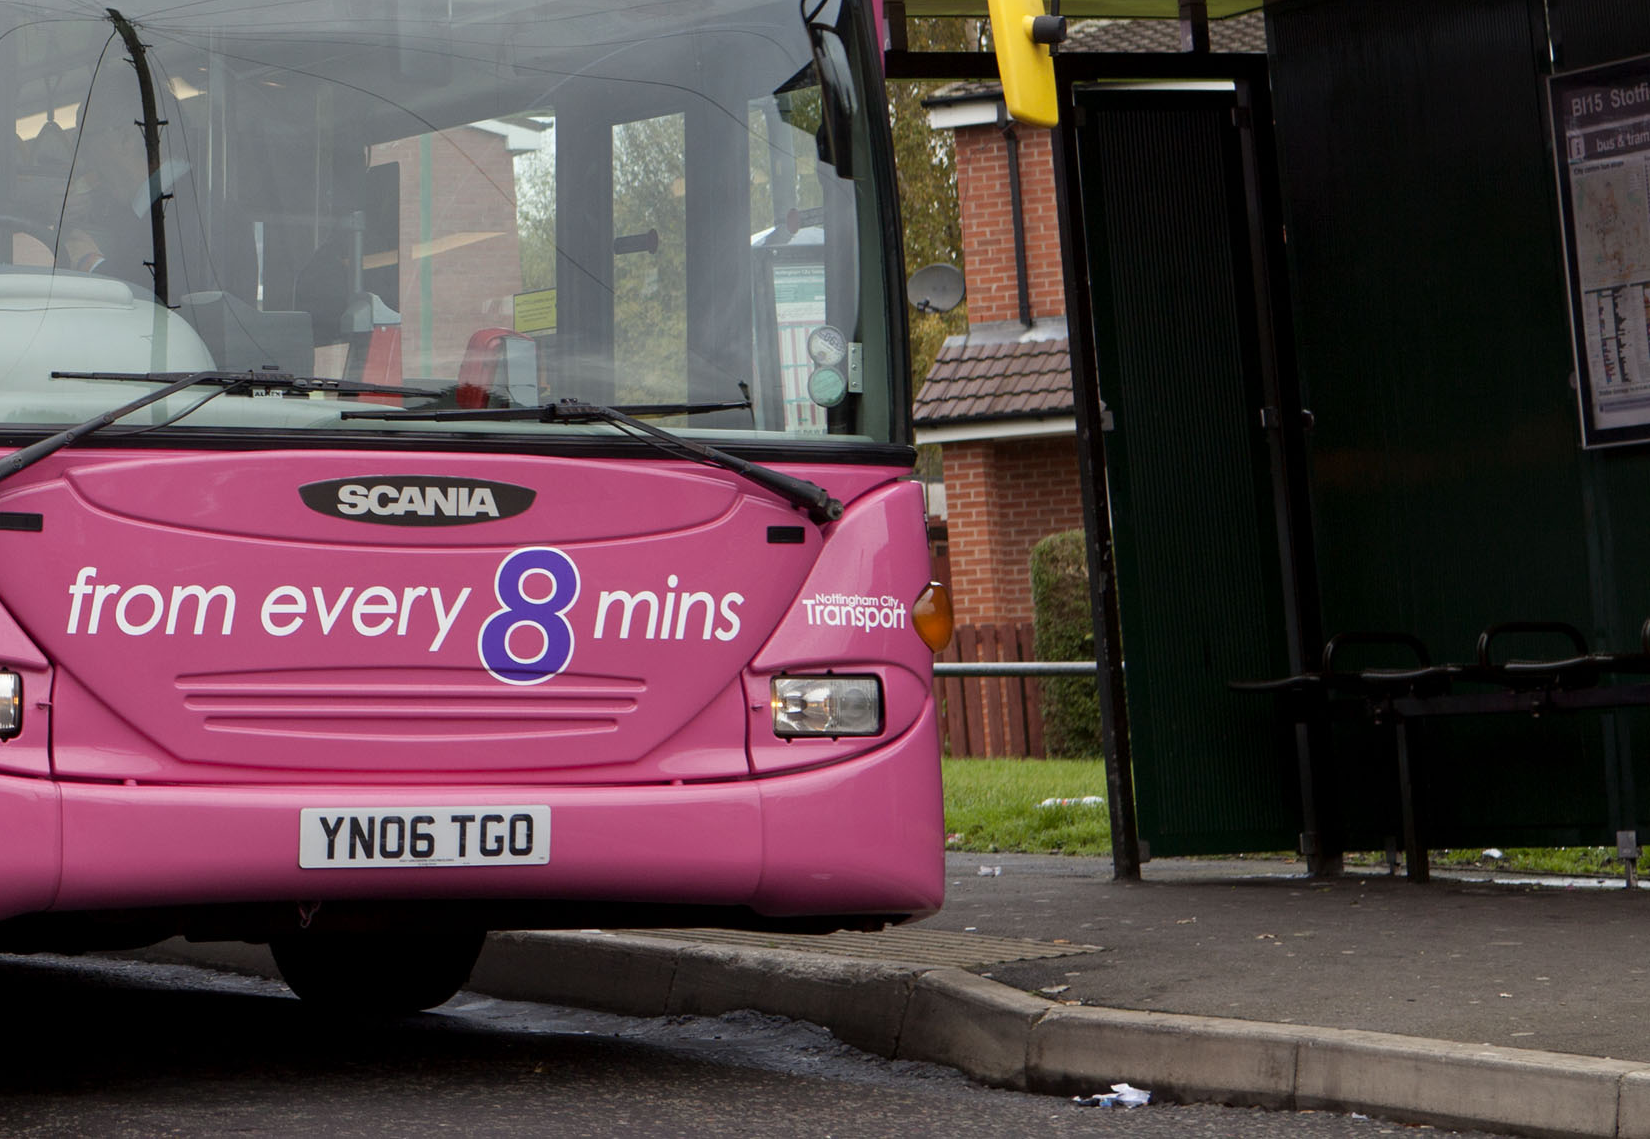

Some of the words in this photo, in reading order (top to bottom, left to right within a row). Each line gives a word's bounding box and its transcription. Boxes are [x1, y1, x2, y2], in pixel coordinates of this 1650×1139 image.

[1596, 138, 1615, 152] bus
[1616, 133, 1626, 148] &
[336, 484, 501, 517] SCANIA
[66, 566, 237, 636] from
[260, 585, 473, 653] every
[477, 546, 581, 686] 8
[593, 574, 746, 641] mins
[802, 599, 907, 633] Transport
[815, 593, 879, 607] Nottingham
[880, 595, 899, 609] City
[319, 815, 436, 860] YN06
[451, 813, 534, 858] TGO
